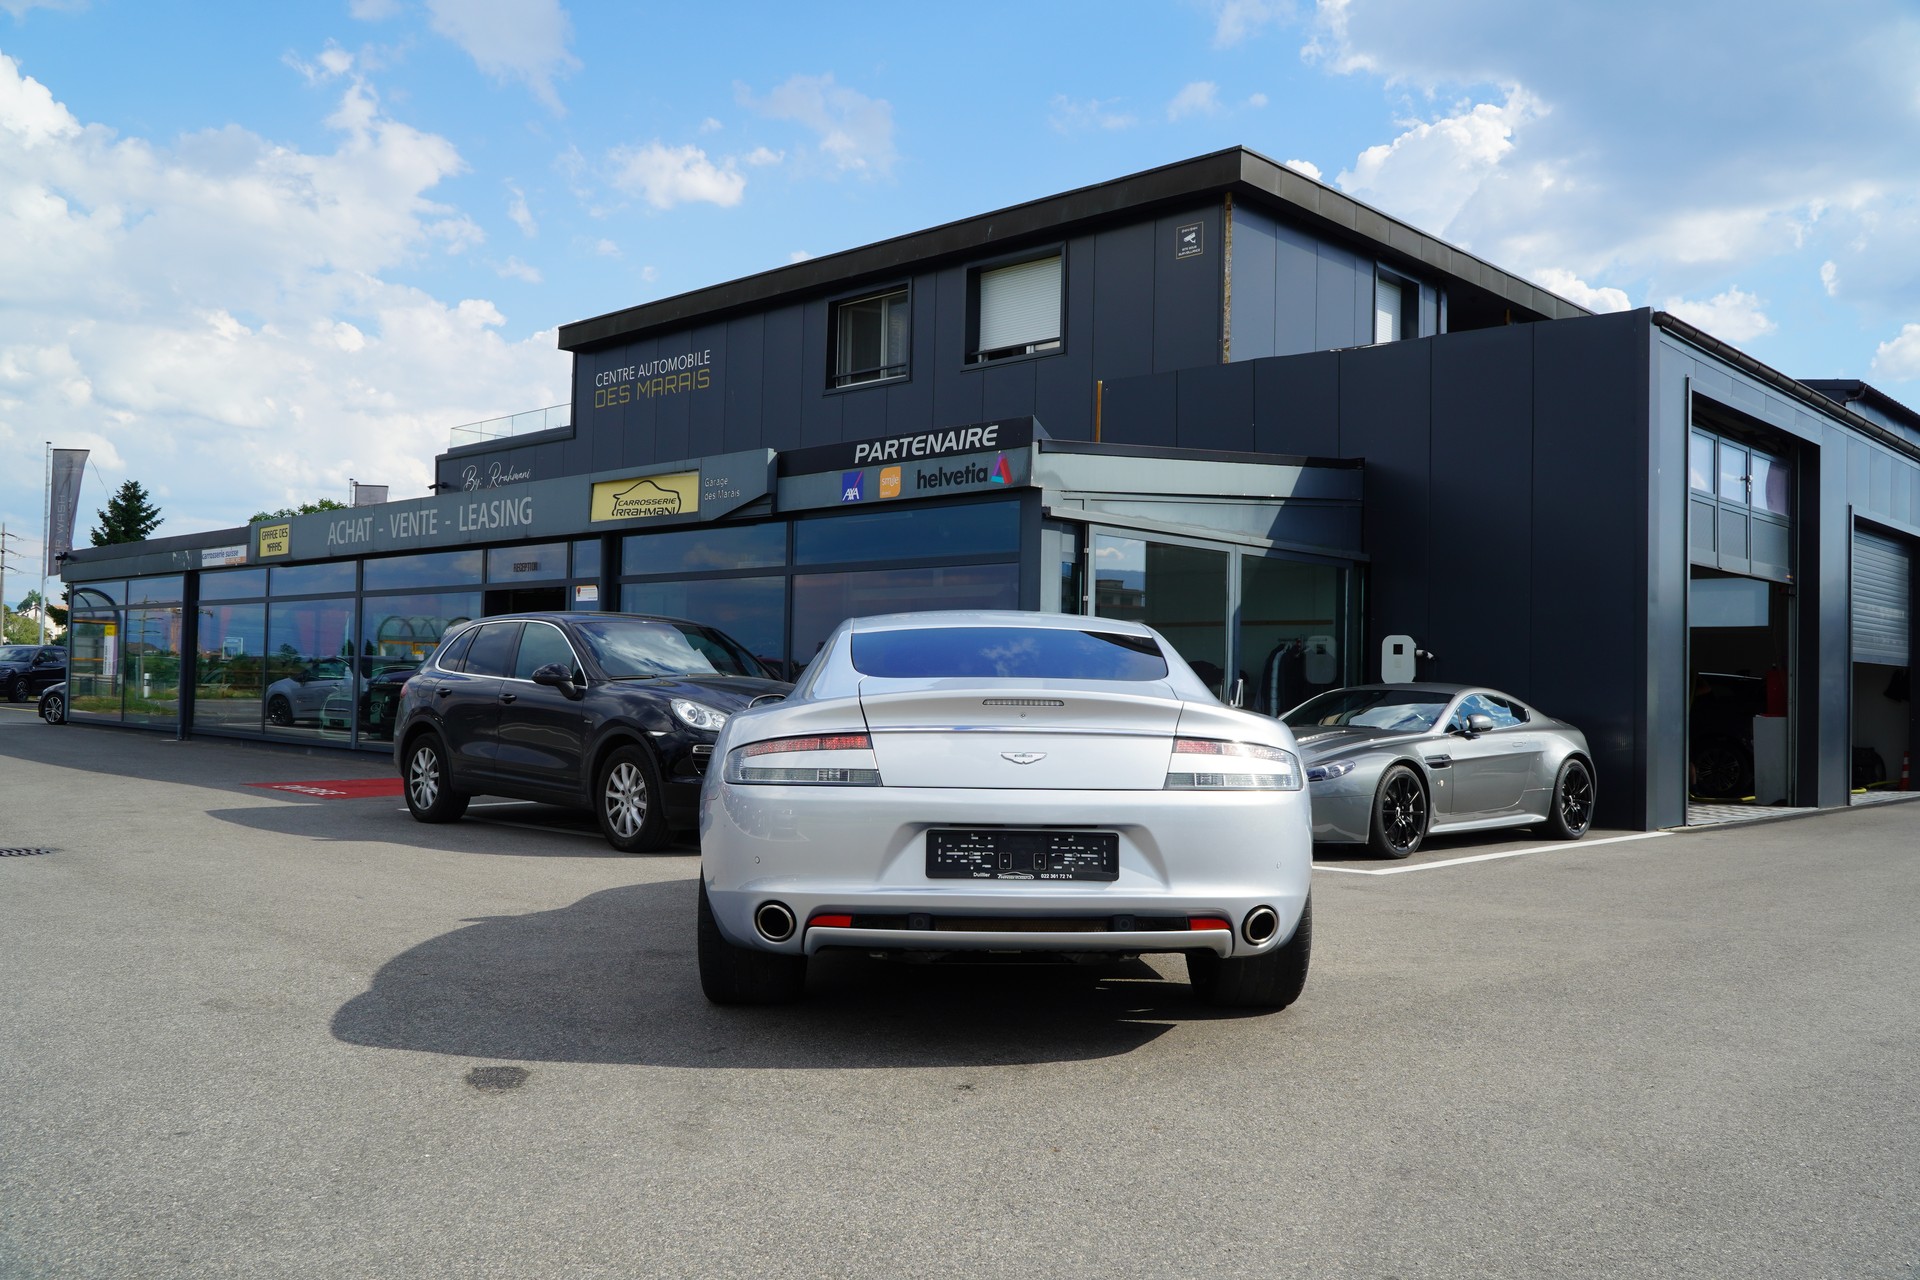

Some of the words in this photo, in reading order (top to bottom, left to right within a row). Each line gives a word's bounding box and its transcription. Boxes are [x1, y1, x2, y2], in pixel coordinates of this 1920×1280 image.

[595, 365, 636, 387] CENTRE
[637, 349, 711, 378] AUTOMOBILE
[595, 384, 631, 409] DES
[636, 368, 710, 401] MARAIS
[854, 424, 999, 464] PARTENAIRE
[704, 476, 729, 488] Garage
[916, 462, 988, 490] helvetia
[617, 497, 677, 507] CARROSSERIE
[704, 490, 716, 501] des
[717, 488, 741, 499] Marais
[842, 487, 860, 501] AXA
[55, 494, 66, 533] WASH
[327, 516, 373, 546] ACHAT
[390, 509, 438, 539] VENTE
[458, 496, 533, 532] LEASING
